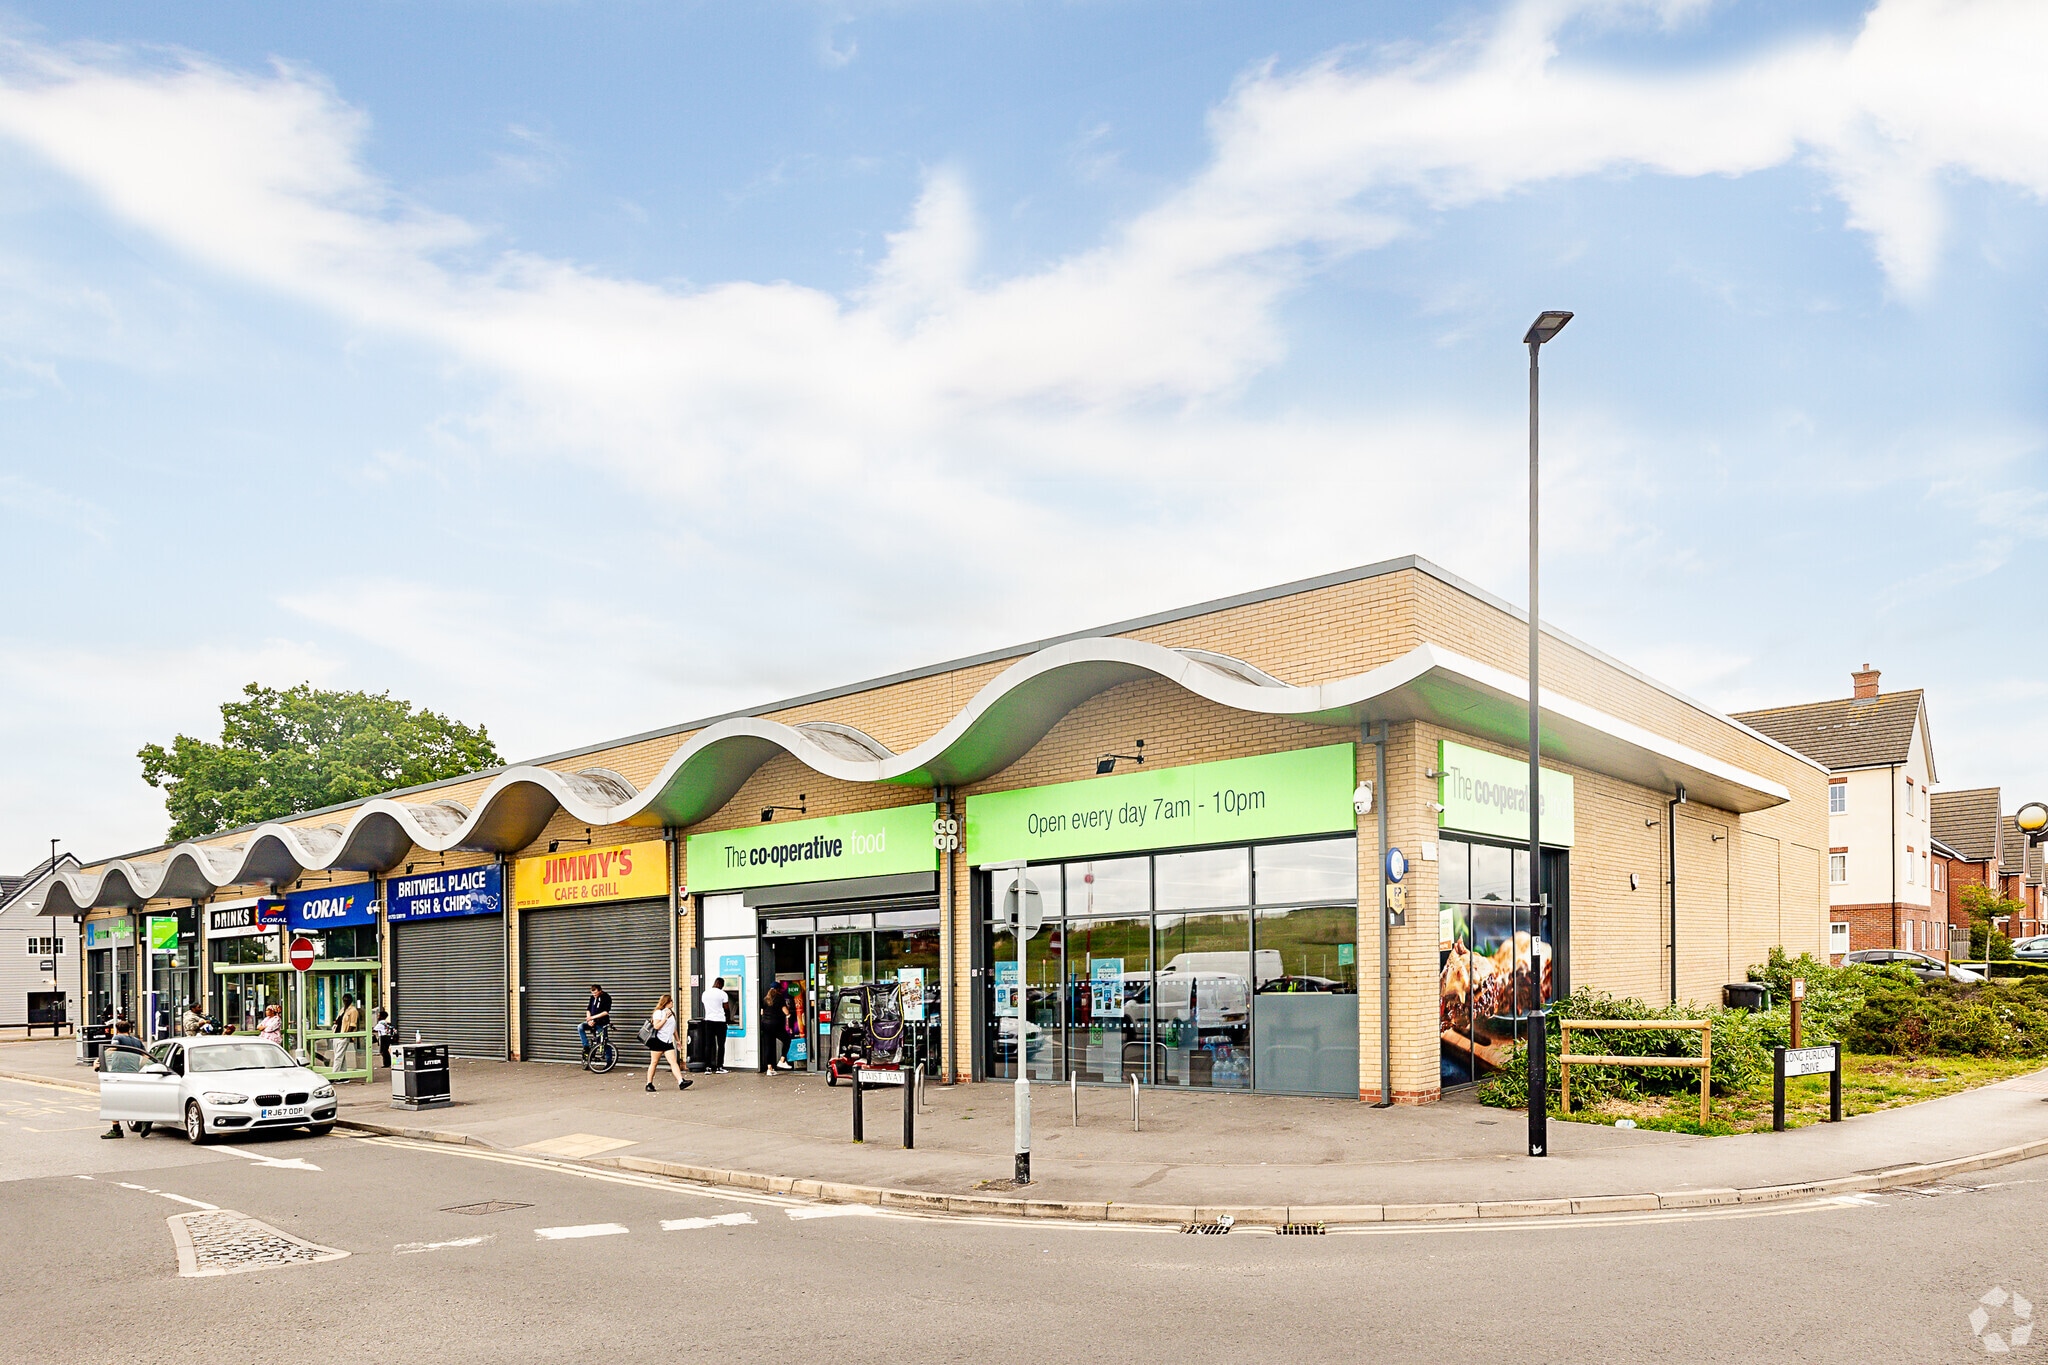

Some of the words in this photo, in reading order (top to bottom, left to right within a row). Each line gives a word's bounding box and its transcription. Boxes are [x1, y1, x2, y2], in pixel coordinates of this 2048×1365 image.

[1450, 766, 1472, 801] The
[1474, 779, 1545, 815] co-operate
[1028, 813, 1066, 838] Open
[1072, 808, 1113, 831] every
[1118, 802, 1147, 827] day
[1153, 798, 1190, 820] 7am
[1213, 789, 1265, 816] 10pm
[725, 846, 747, 868] The
[851, 827, 885, 865] food
[543, 849, 632, 885] JIMMY'S
[398, 876, 446, 898] BRITWELL
[448, 871, 486, 892] PLAICE
[554, 886, 578, 900] CAFE
[581, 885, 588, 898] &
[591, 882, 619, 897] GRILL
[302, 897, 347, 920] CORAL
[411, 898, 431, 915] FISH
[433, 897, 441, 913] &
[442, 894, 472, 912] CHIPS
[214, 908, 250, 929] DRINKS
[726, 958, 739, 967] Free
[1785, 1051, 1803, 1063] LONG
[1805, 1049, 1835, 1061] FURLONG
[860, 1071, 882, 1081] TWIST
[885, 1072, 904, 1083] WAY
[1801, 1061, 1819, 1073] DRIVE
[267, 1109, 287, 1117] RJ67
